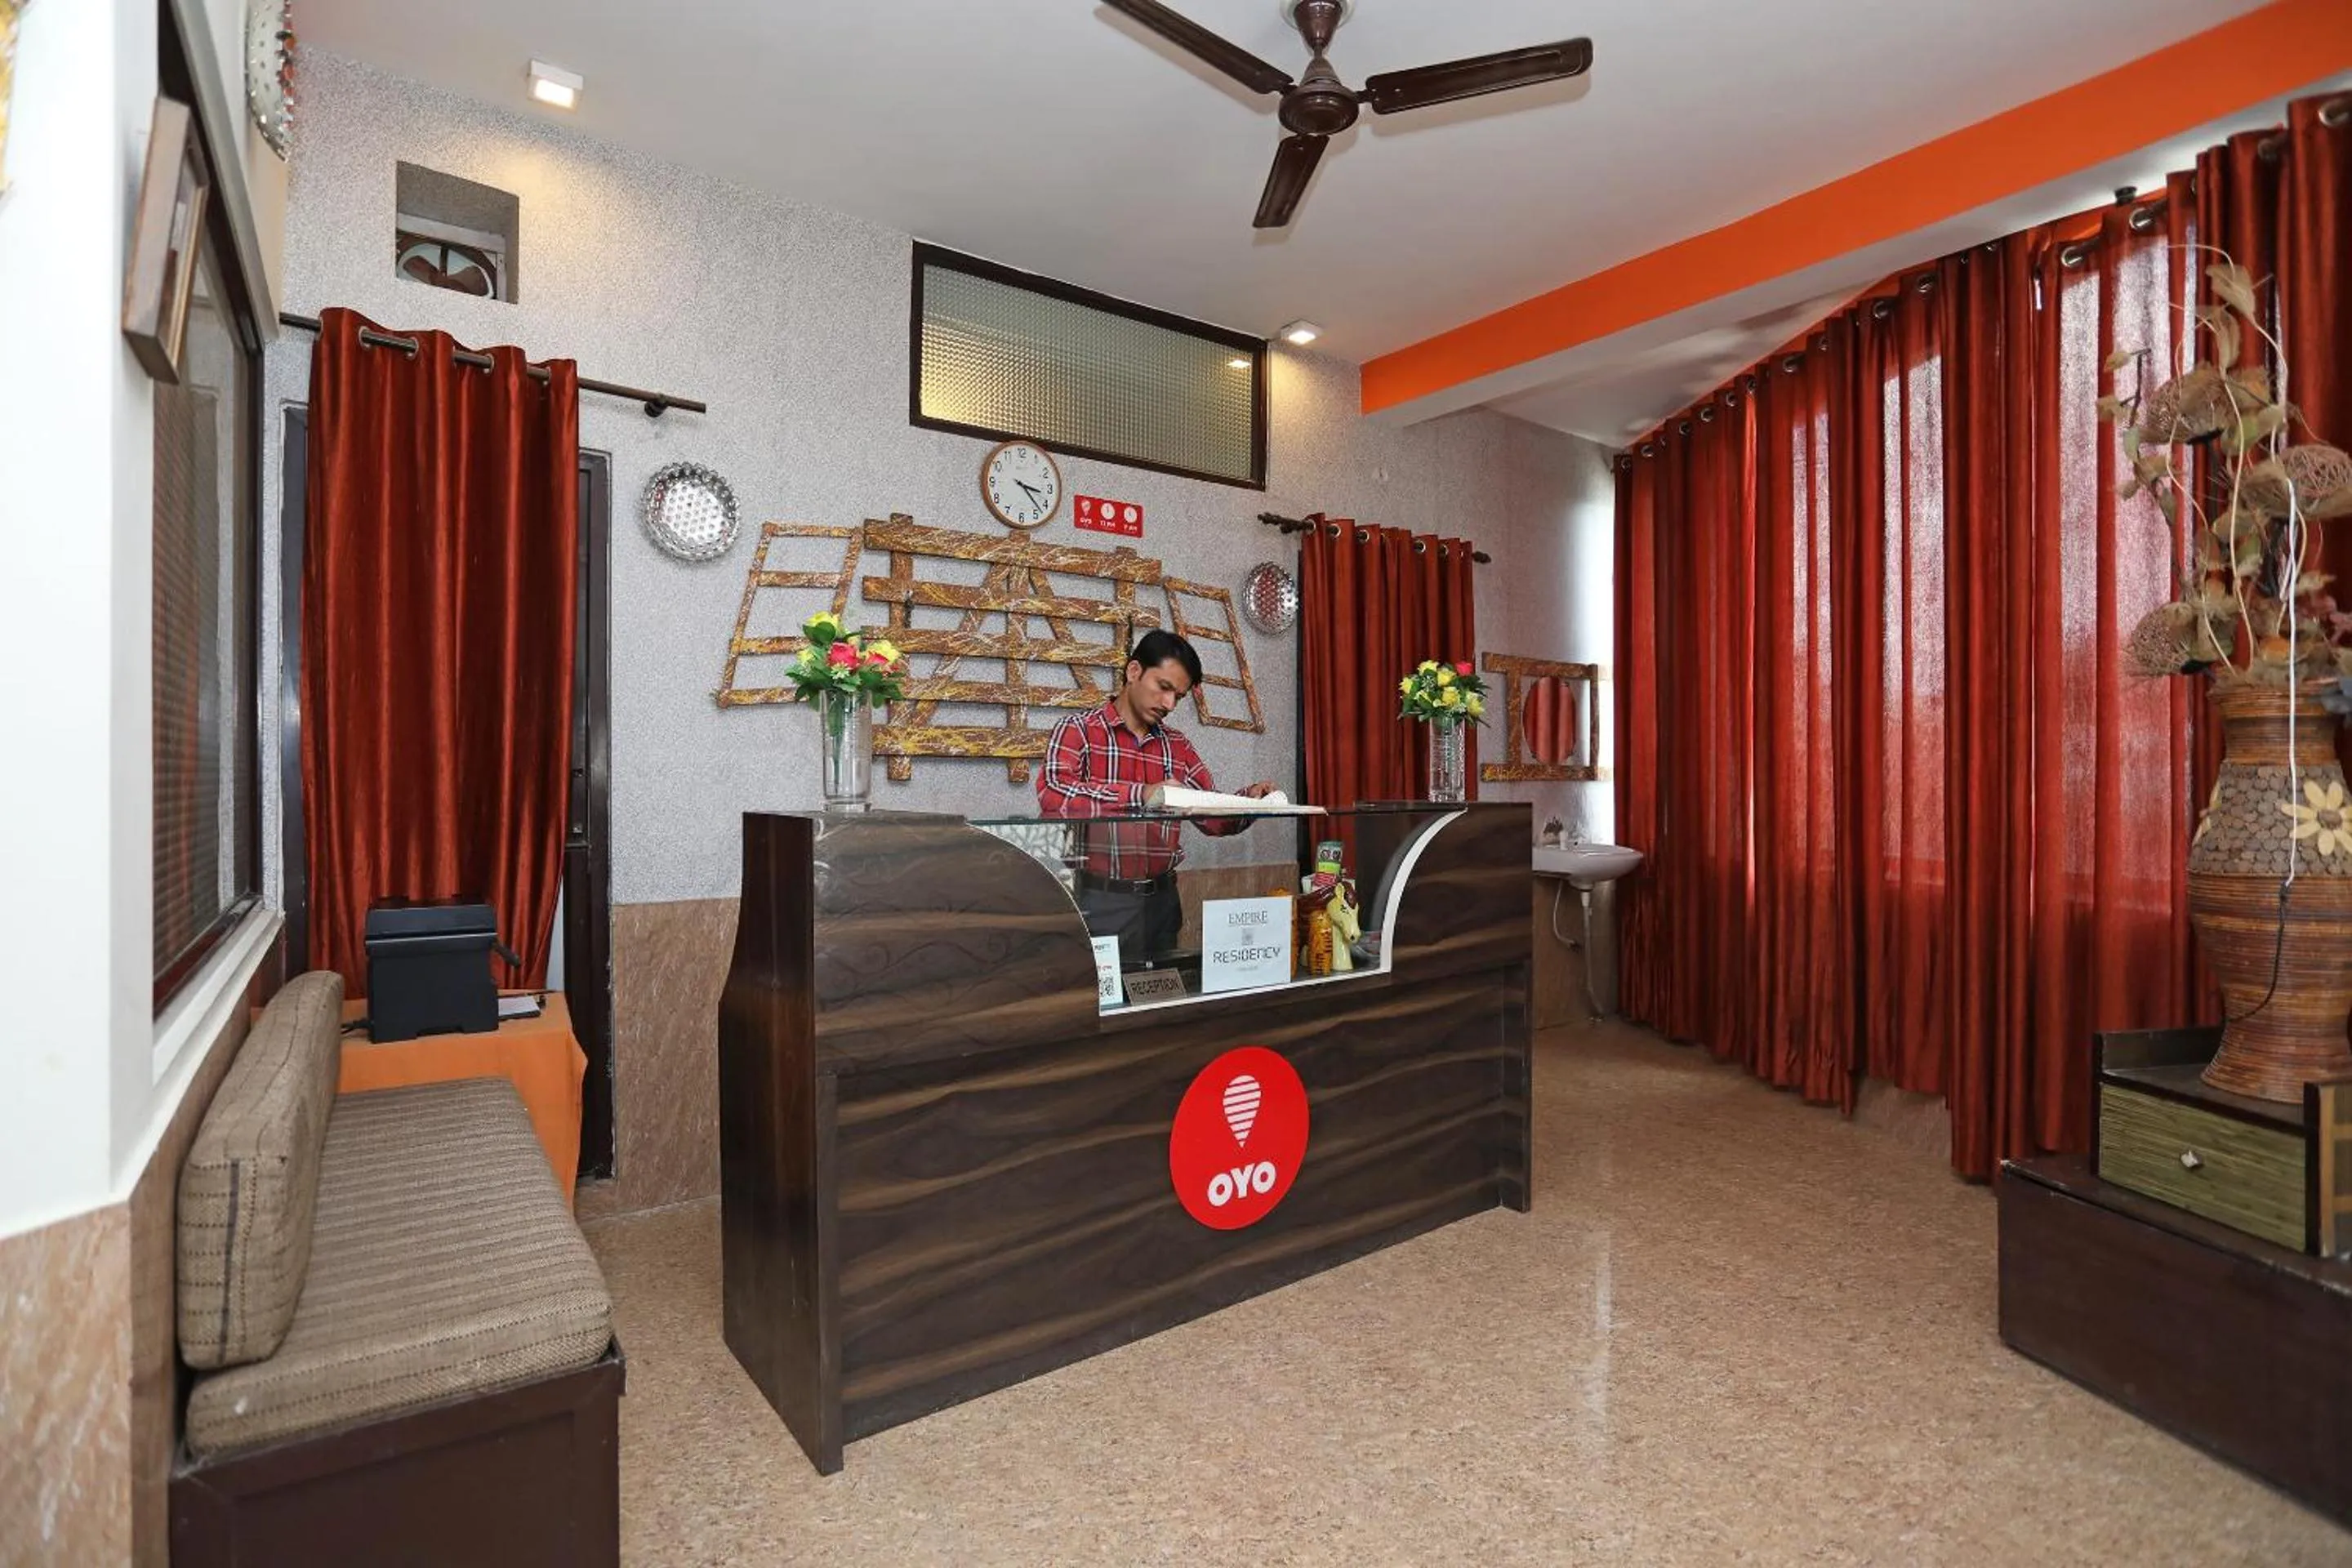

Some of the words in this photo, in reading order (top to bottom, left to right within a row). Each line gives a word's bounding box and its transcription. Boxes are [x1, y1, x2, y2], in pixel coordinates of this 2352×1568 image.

[1004, 451, 1011, 464] 11
[1018, 448, 1027, 458] 12
[1042, 466, 1049, 479] 2
[989, 476, 995, 488] 9
[1046, 483, 1054, 495] 3
[993, 492, 1000, 504] 8
[1042, 499, 1049, 510] 4
[1018, 512, 1025, 523] 6
[1032, 509, 1039, 519] 5
[1228, 911, 1268, 926] EMPIRE
[1213, 947, 1281, 964] RESIDENCY
[1129, 978, 1180, 995] RECEPTION
[1207, 1160, 1276, 1206] OYO
